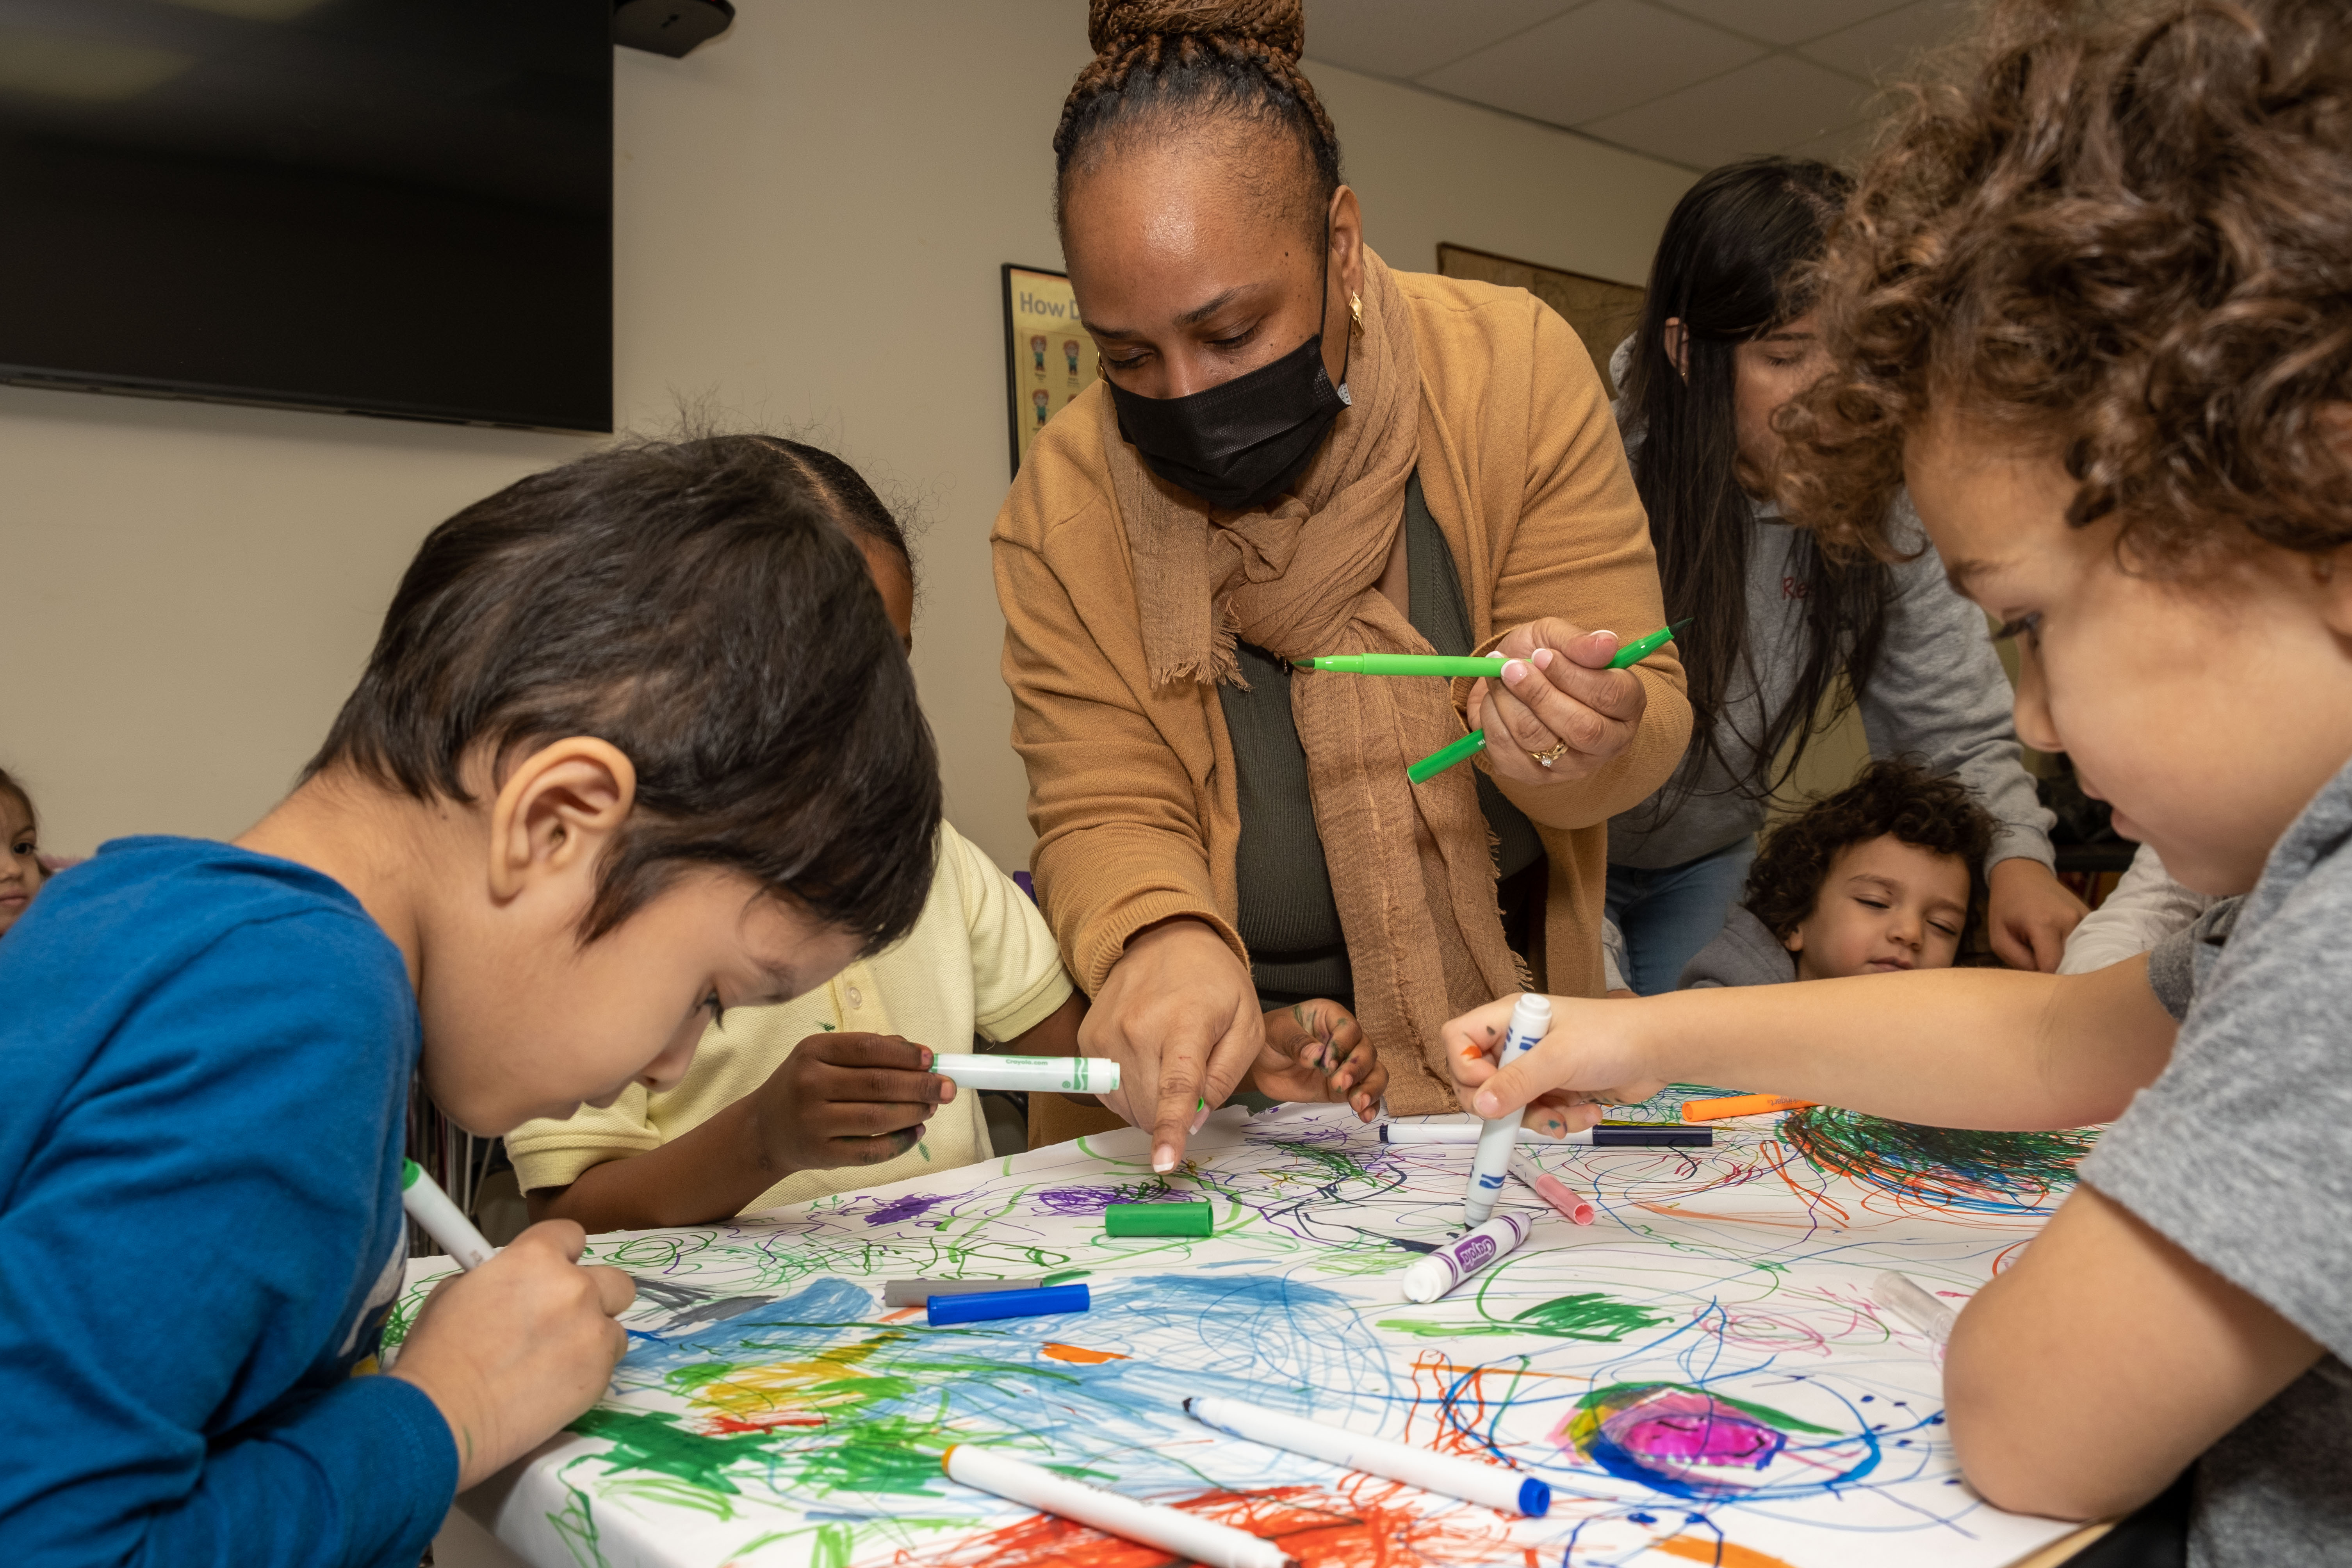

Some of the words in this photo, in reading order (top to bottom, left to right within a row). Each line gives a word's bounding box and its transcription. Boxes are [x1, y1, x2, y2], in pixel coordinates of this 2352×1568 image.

[1020, 291, 1065, 317] How
[1069, 299, 1081, 319] D
[1782, 577, 1807, 600] Re
[1460, 1239, 1493, 1265] Crayola
